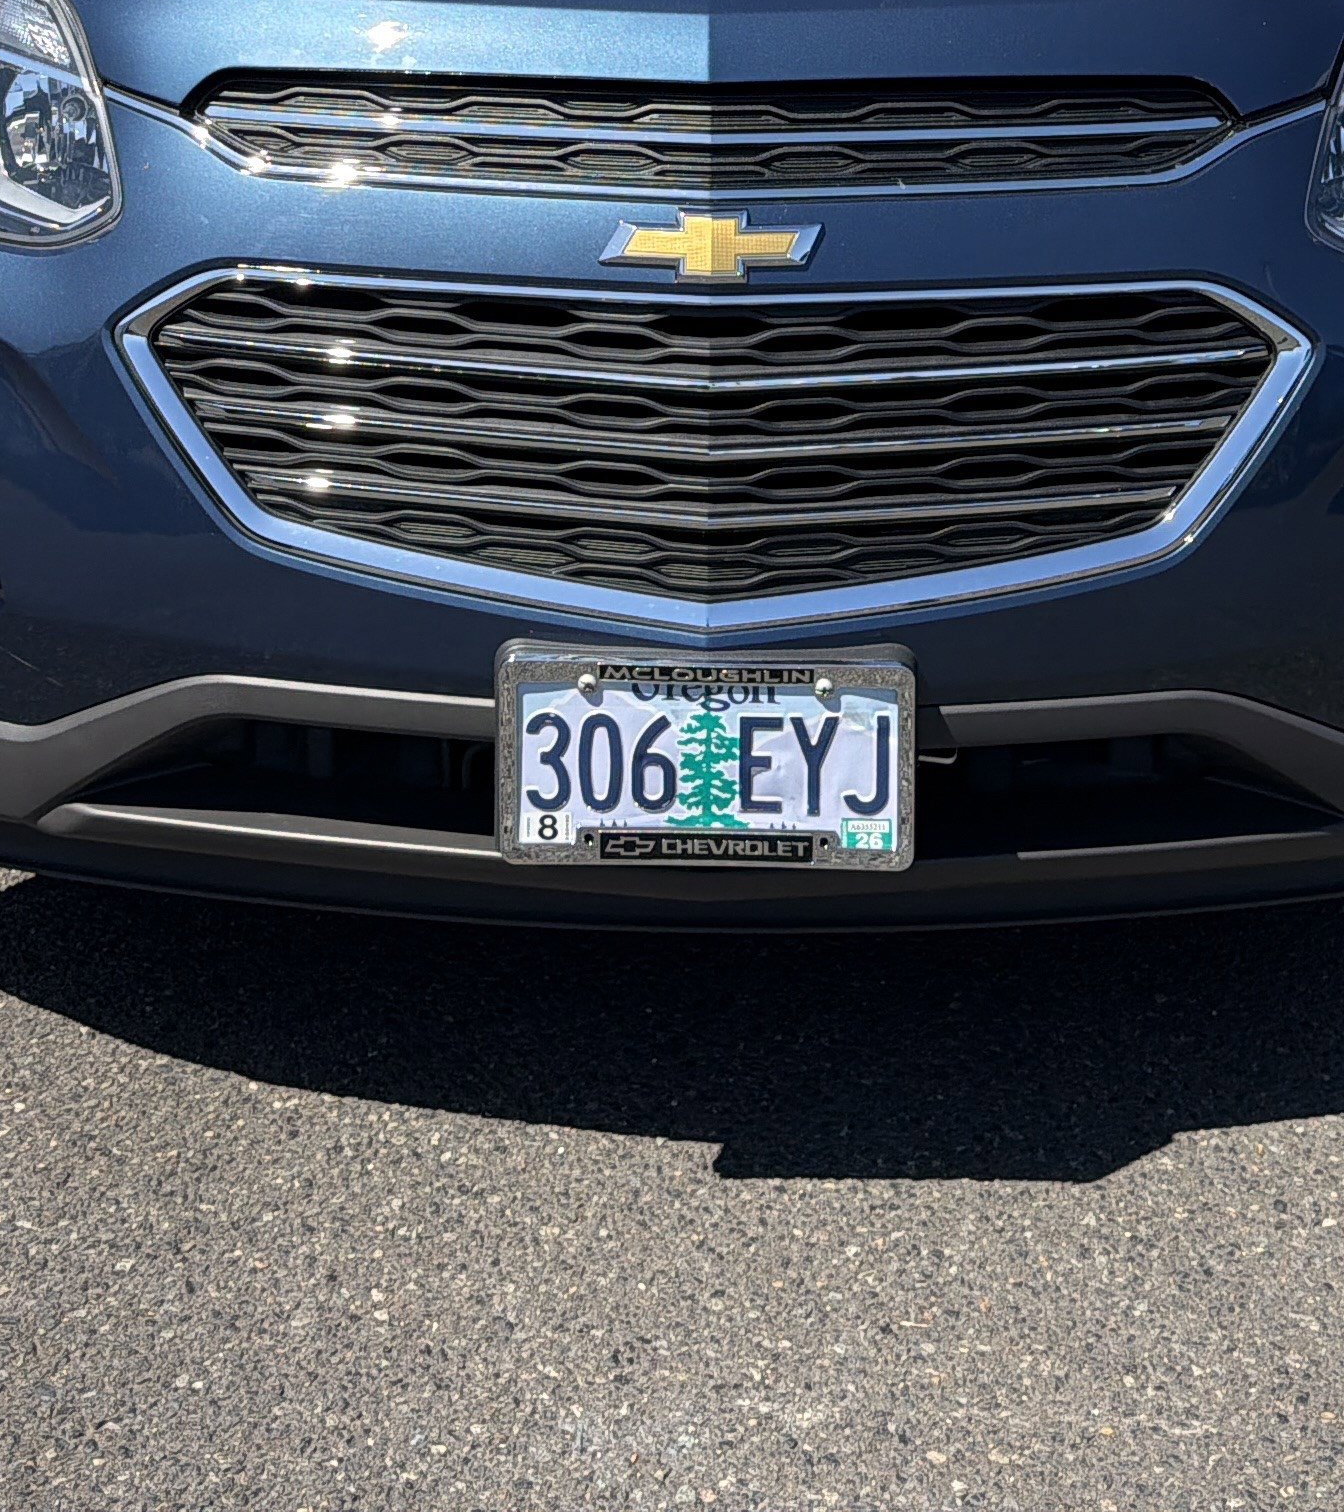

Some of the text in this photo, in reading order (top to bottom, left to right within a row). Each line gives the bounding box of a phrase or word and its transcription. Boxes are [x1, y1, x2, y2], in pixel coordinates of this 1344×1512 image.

[604, 666, 811, 684] MCLOUGHLIN
[526, 712, 891, 816] 306 EYJ
[538, 814, 559, 840] 8
[661, 839, 809, 857] CHEVROLET
[856, 833, 884, 849] 26
